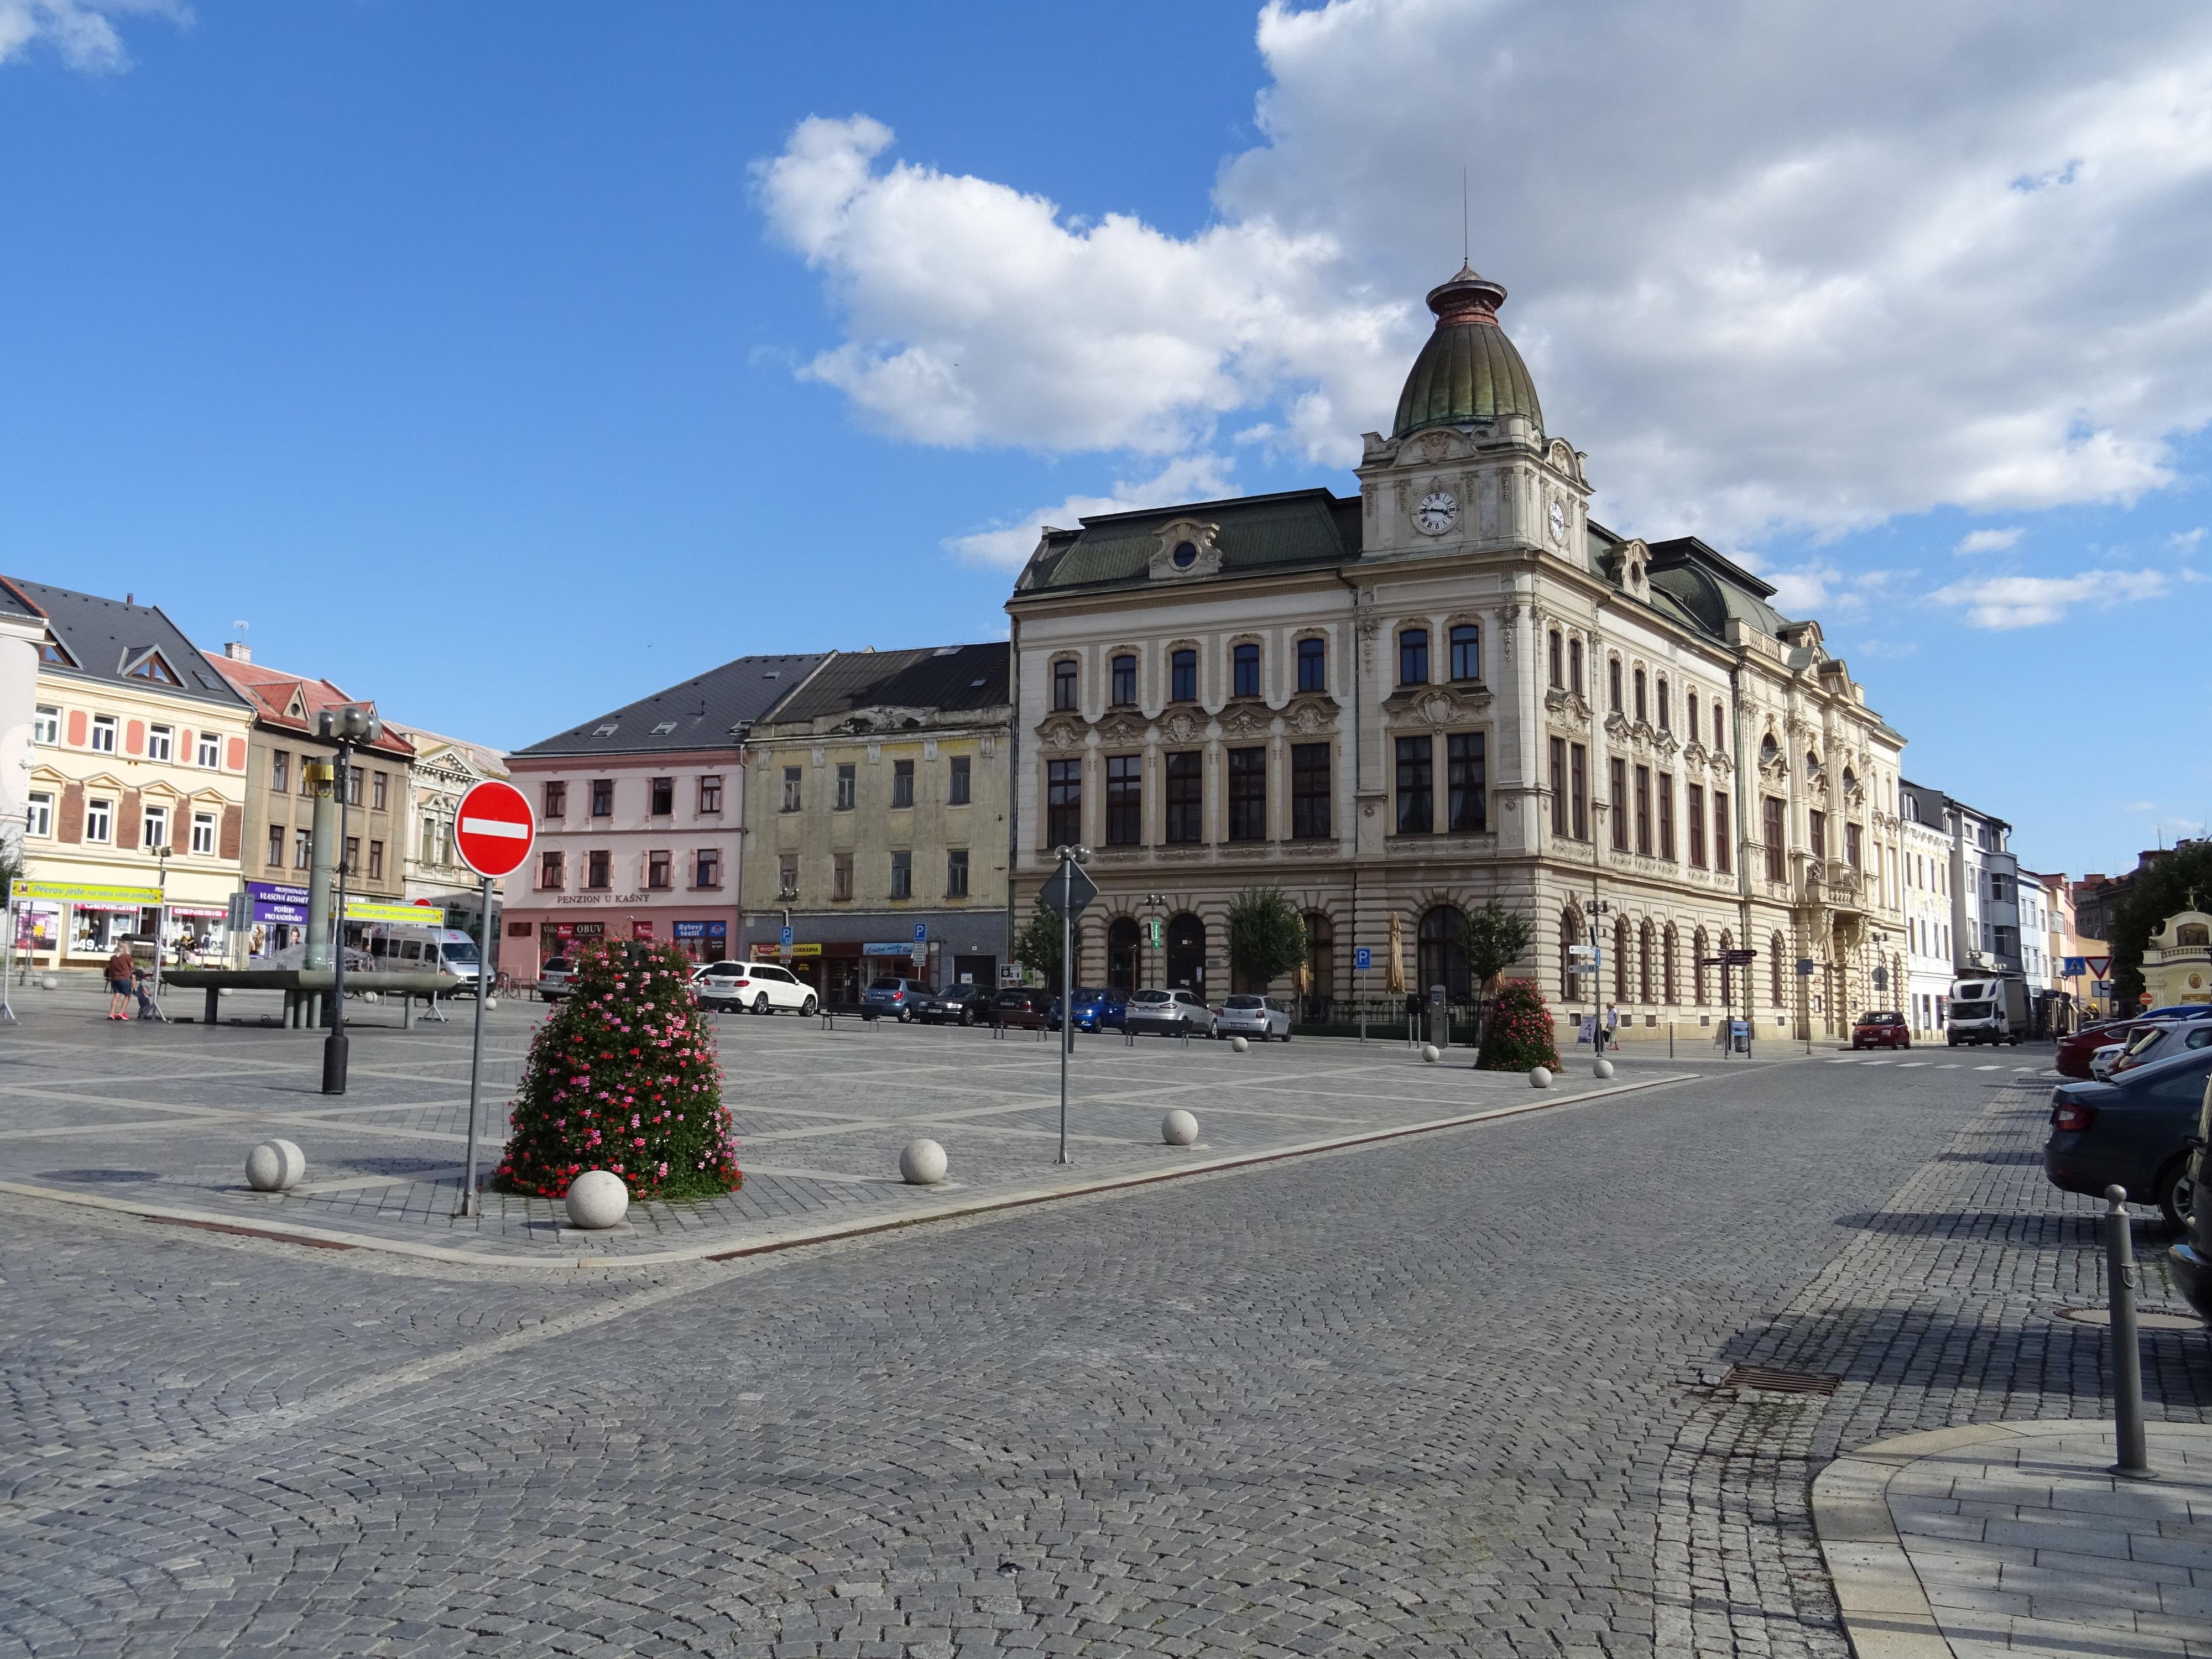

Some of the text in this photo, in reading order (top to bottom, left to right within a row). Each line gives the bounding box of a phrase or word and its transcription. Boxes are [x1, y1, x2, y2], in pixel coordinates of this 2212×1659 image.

[260, 892, 286, 901] VLASOVÁ
[557, 895, 600, 904] PENZION
[174, 908, 222, 916] GENESIS
[274, 905, 295, 914] POTŘEBY
[577, 925, 603, 933] OBUV
